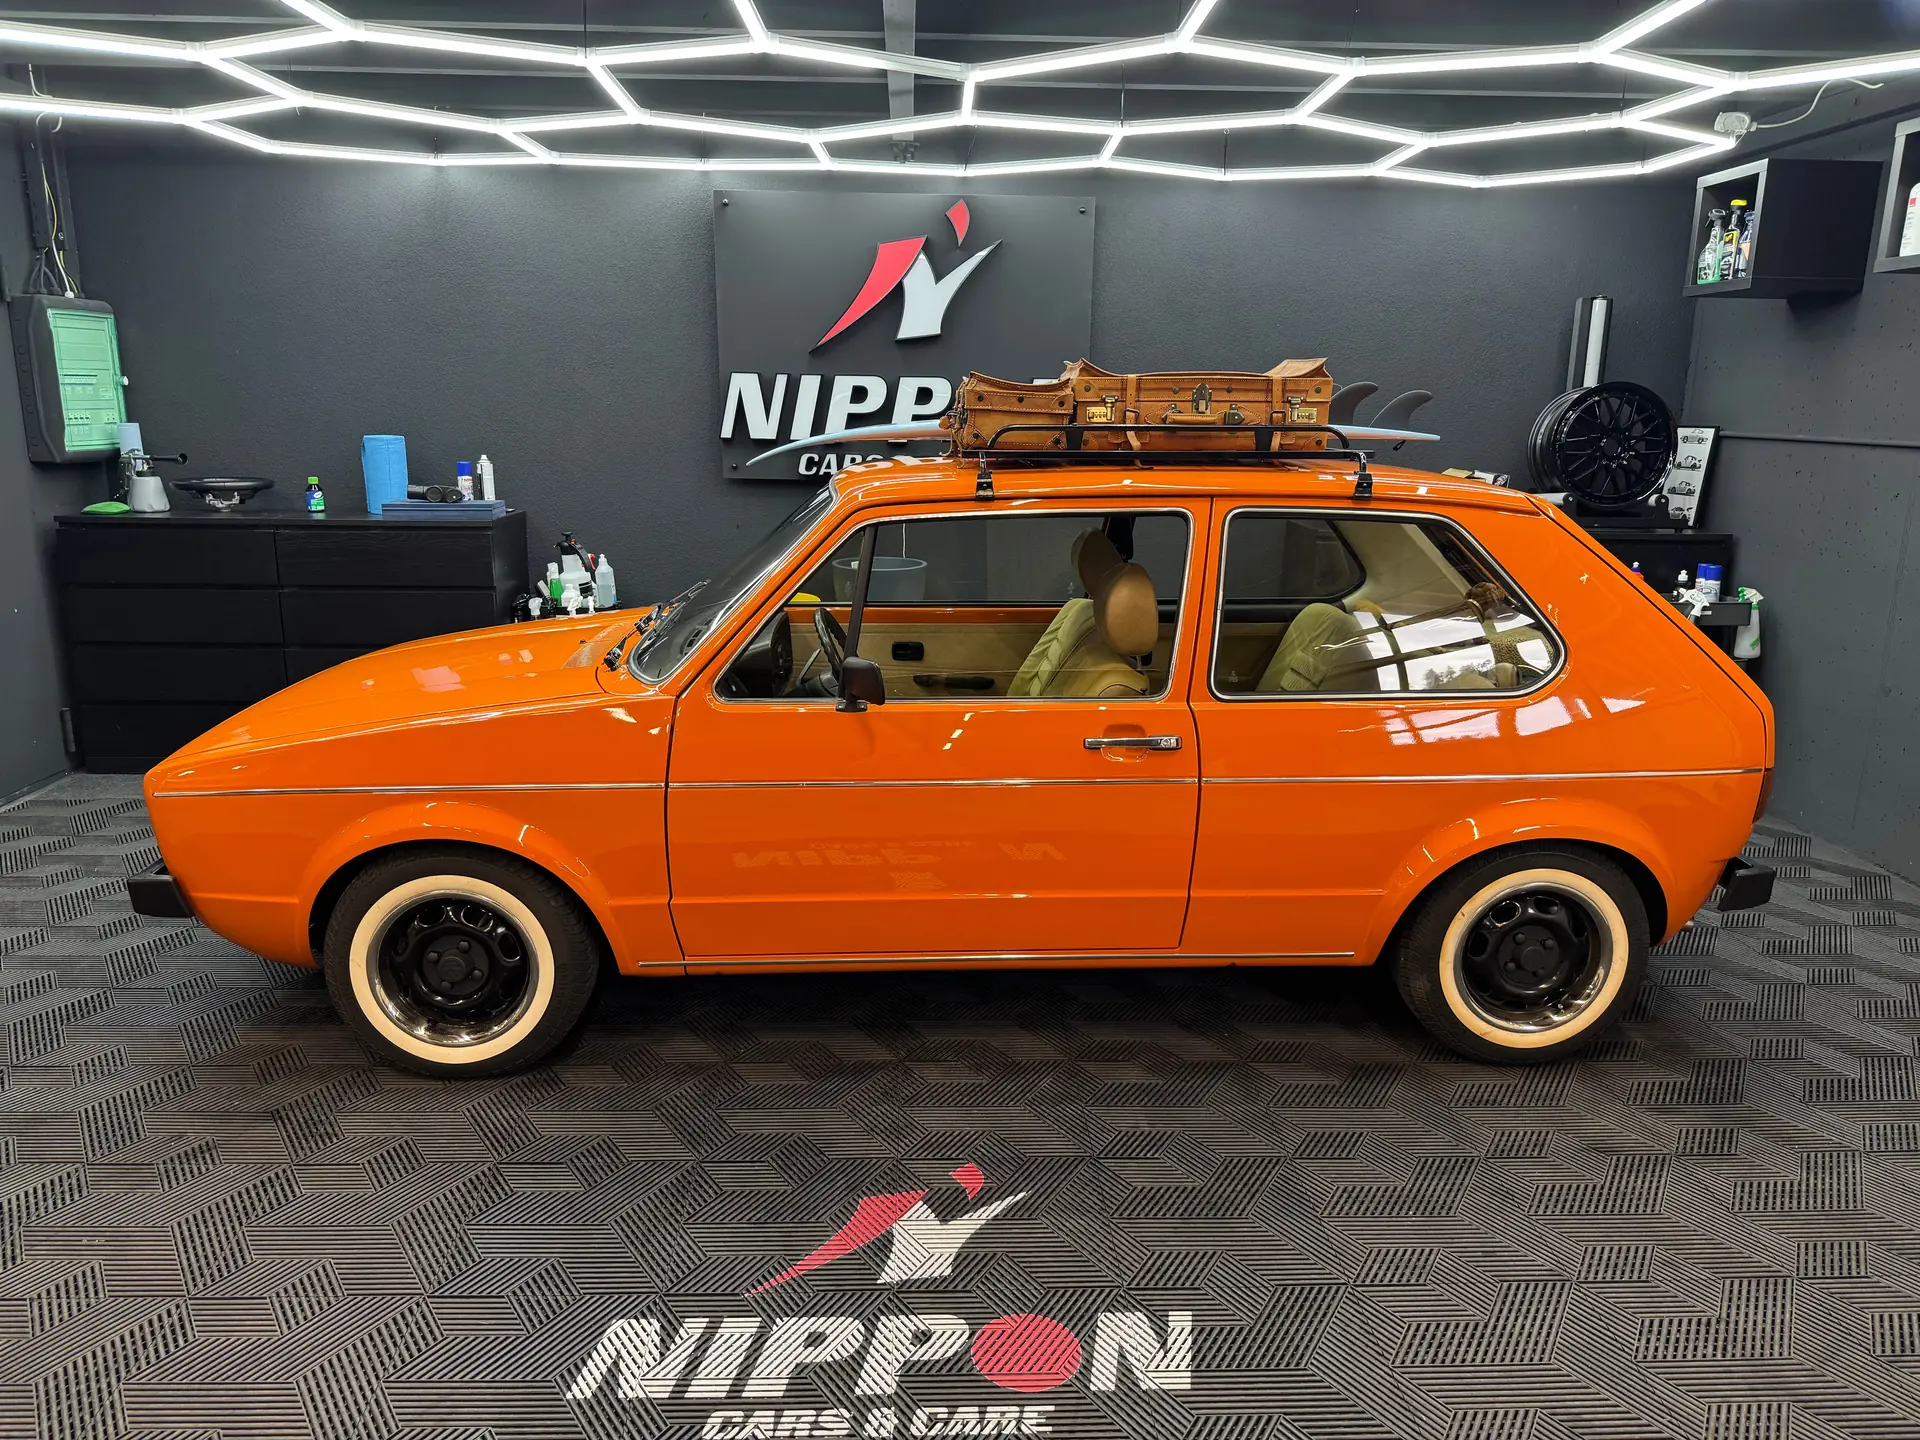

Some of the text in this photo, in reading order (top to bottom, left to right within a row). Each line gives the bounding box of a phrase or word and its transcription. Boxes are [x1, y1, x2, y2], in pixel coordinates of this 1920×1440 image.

[719, 371, 1061, 443] NIPP
[565, 1311, 1193, 1401] NIPPON
[701, 1408, 852, 1439] CARS
[909, 1405, 1056, 1437] CARE
